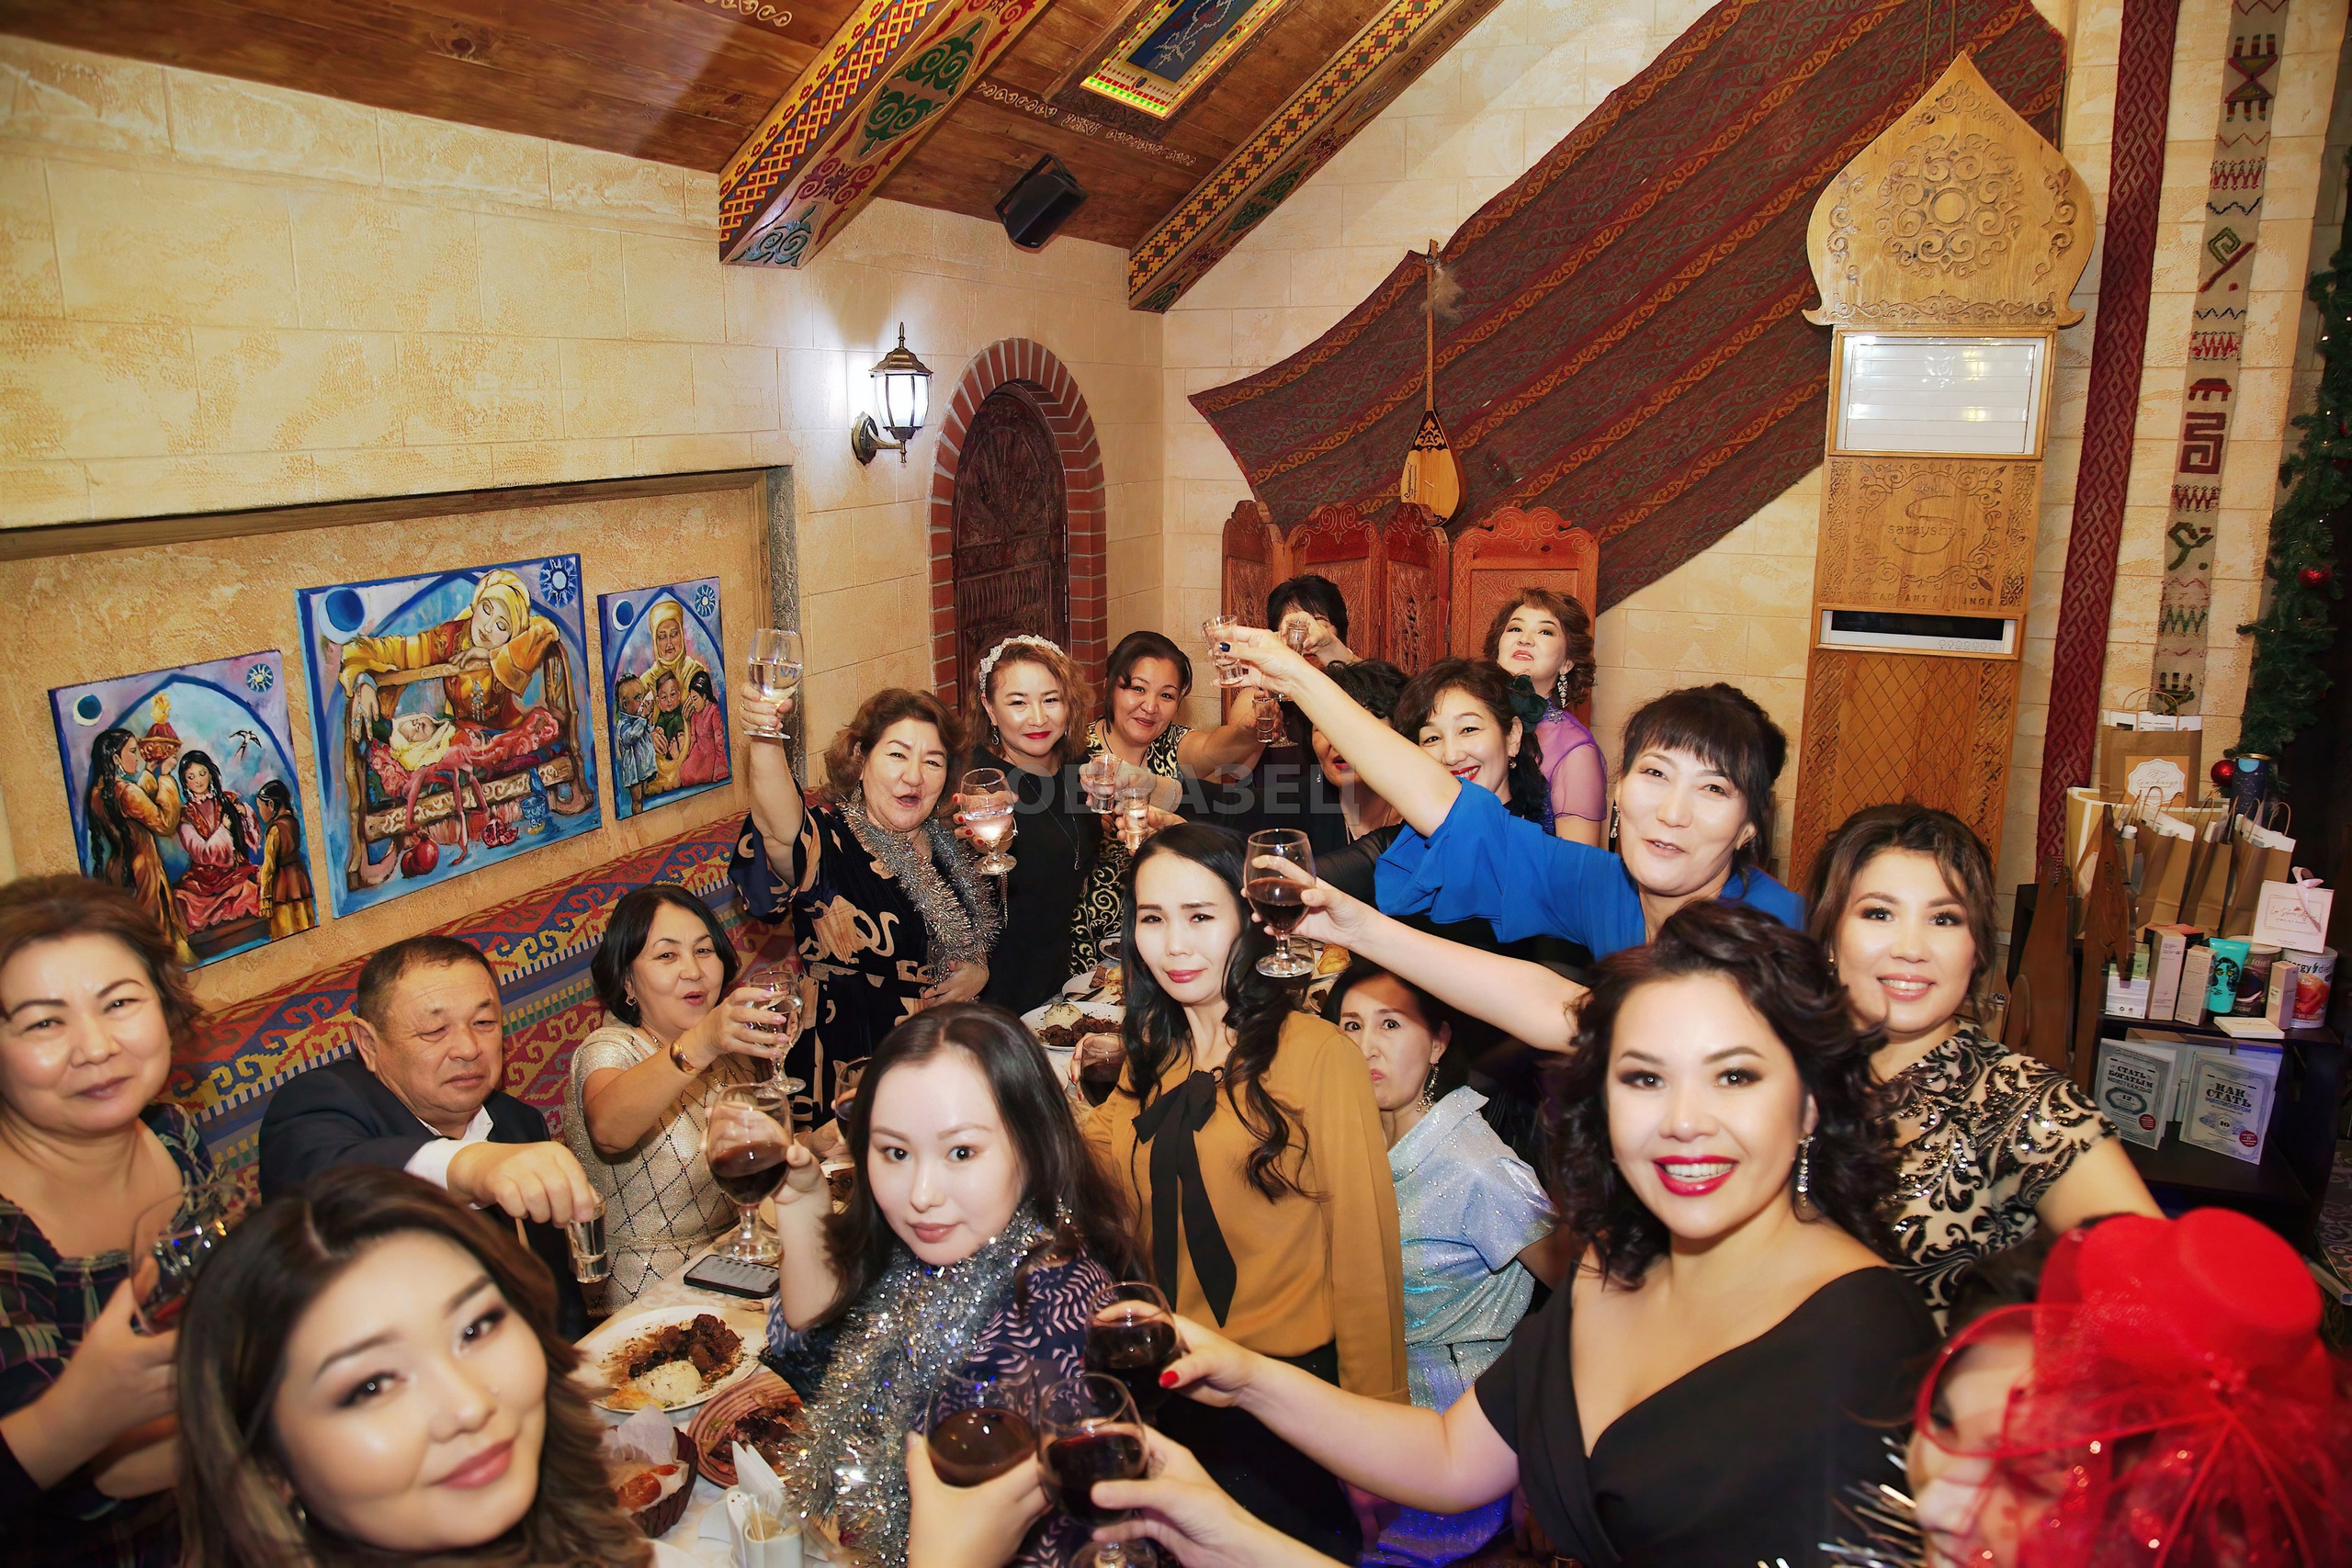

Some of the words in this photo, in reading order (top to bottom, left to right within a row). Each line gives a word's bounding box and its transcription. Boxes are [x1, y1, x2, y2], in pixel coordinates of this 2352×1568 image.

[2109, 1070, 2154, 1089] БОГАТЫМ
[2117, 1066, 2146, 1079] СТАТЬ
[2206, 1089, 2252, 1108] СТАТЬ
[2215, 1083, 2246, 1098] КАК
